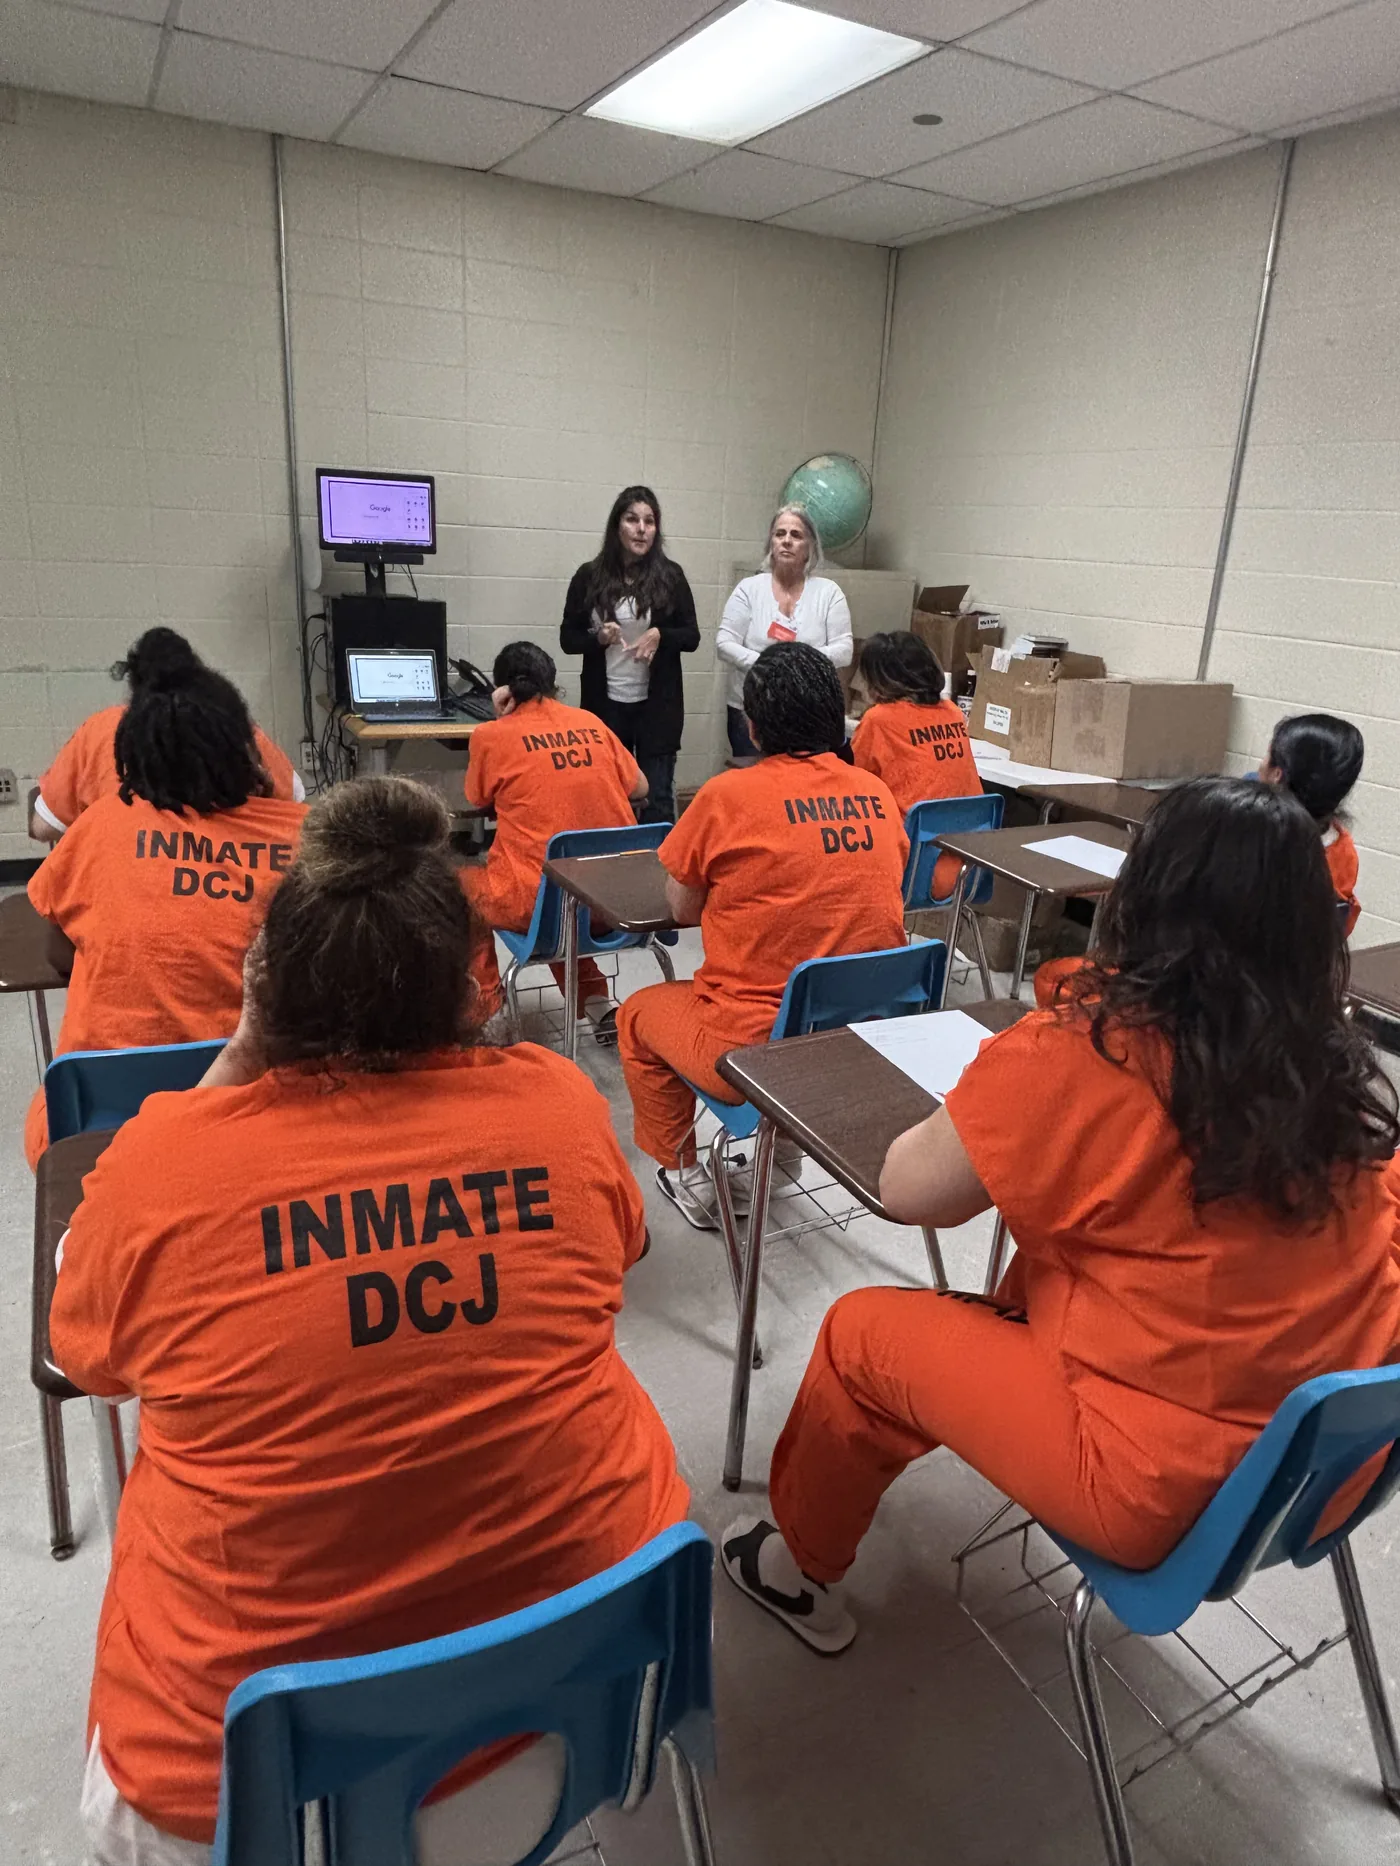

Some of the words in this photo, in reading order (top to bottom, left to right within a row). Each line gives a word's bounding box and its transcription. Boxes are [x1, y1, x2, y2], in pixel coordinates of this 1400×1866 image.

[369, 503, 391, 513] Google
[387, 672, 404, 680] Google
[521, 728, 604, 753] INMATE
[908, 721, 968, 747] INMATE
[550, 747, 593, 770] DCJ
[933, 741, 965, 761] DCJ
[783, 794, 887, 825] INMATE
[135, 829, 293, 871] INMATE
[820, 824, 874, 854] DCJ
[172, 866, 254, 903] DCJ
[260, 1166, 554, 1276] INMATE
[346, 1252, 499, 1348] DCJ
